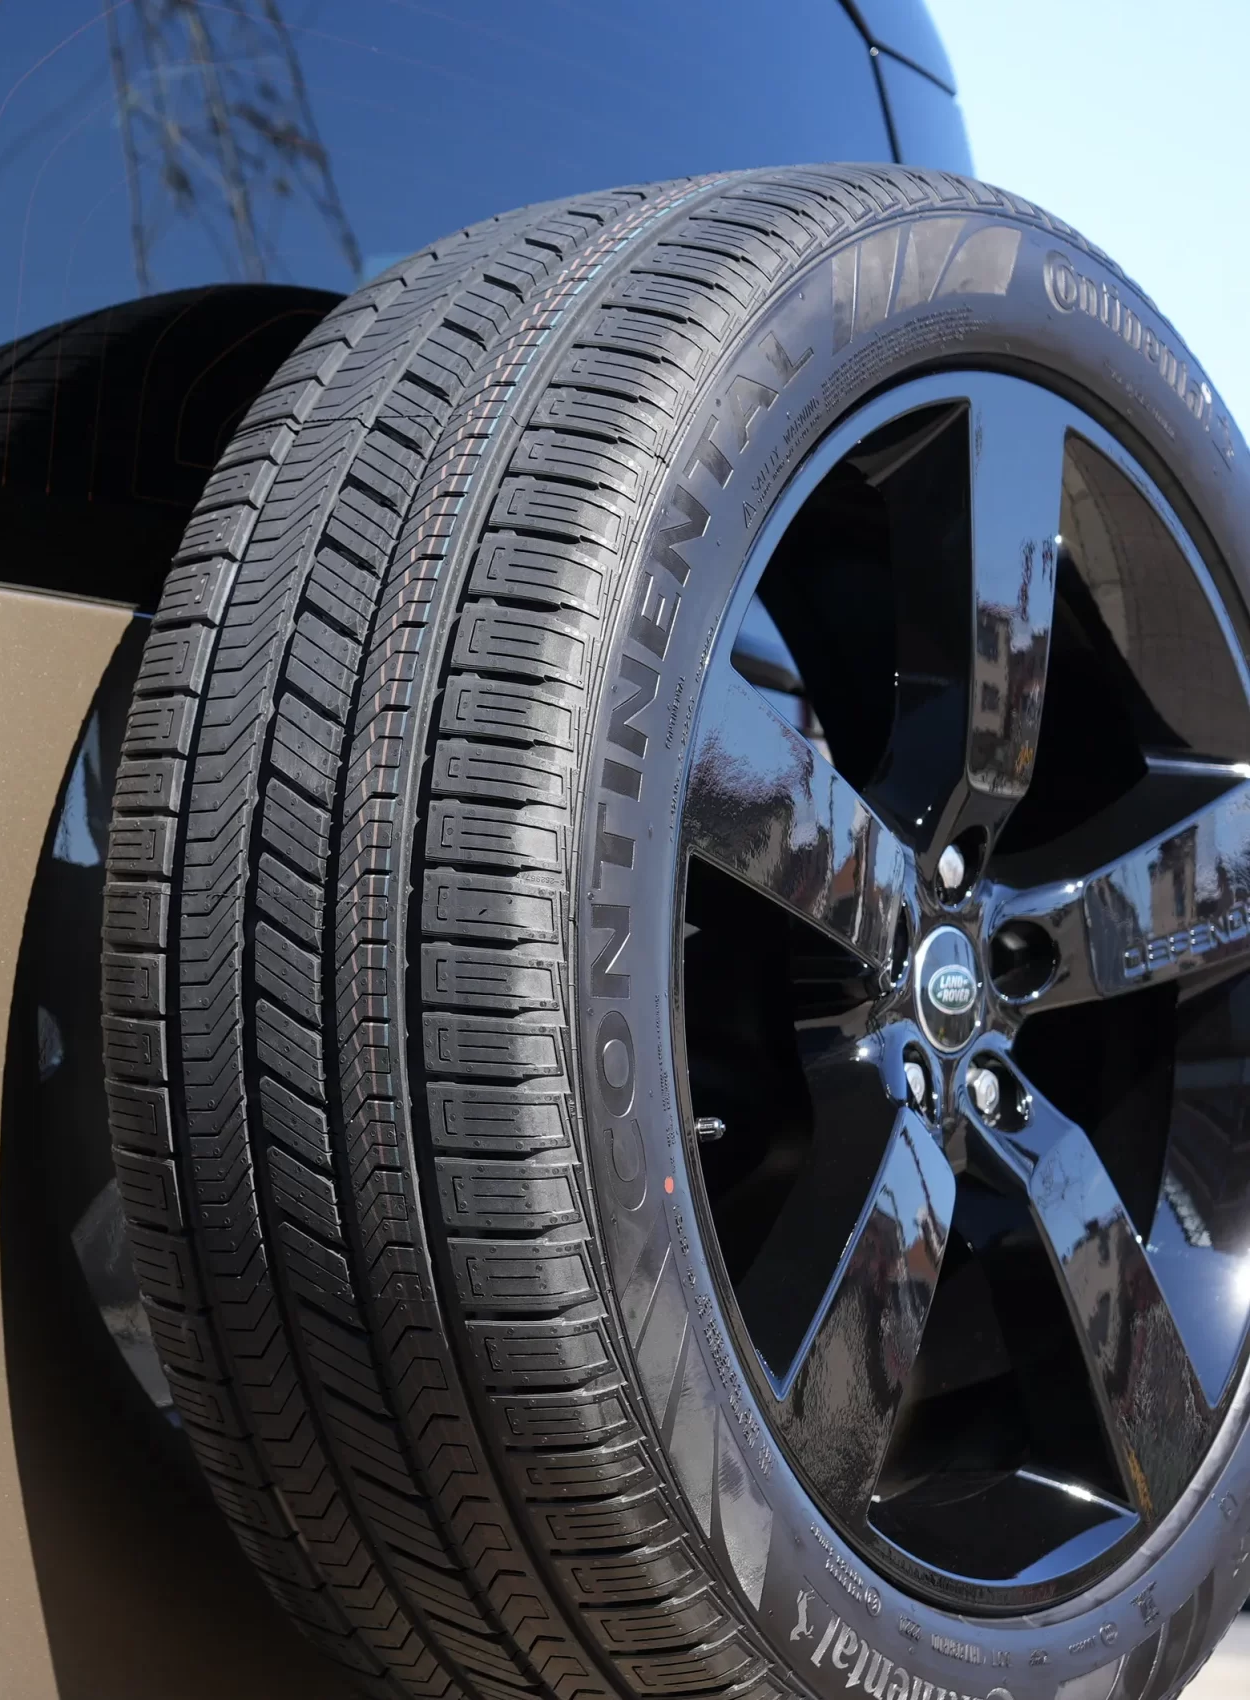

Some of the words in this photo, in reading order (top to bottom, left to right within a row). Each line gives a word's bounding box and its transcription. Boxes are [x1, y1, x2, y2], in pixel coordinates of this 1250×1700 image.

[1044, 250, 1213, 433] Continental
[592, 330, 814, 1211] CONTINENTAL
[1123, 899, 1250, 978] DEFEND
[939, 975, 963, 989] LAND
[941, 987, 971, 1003] ROVER
